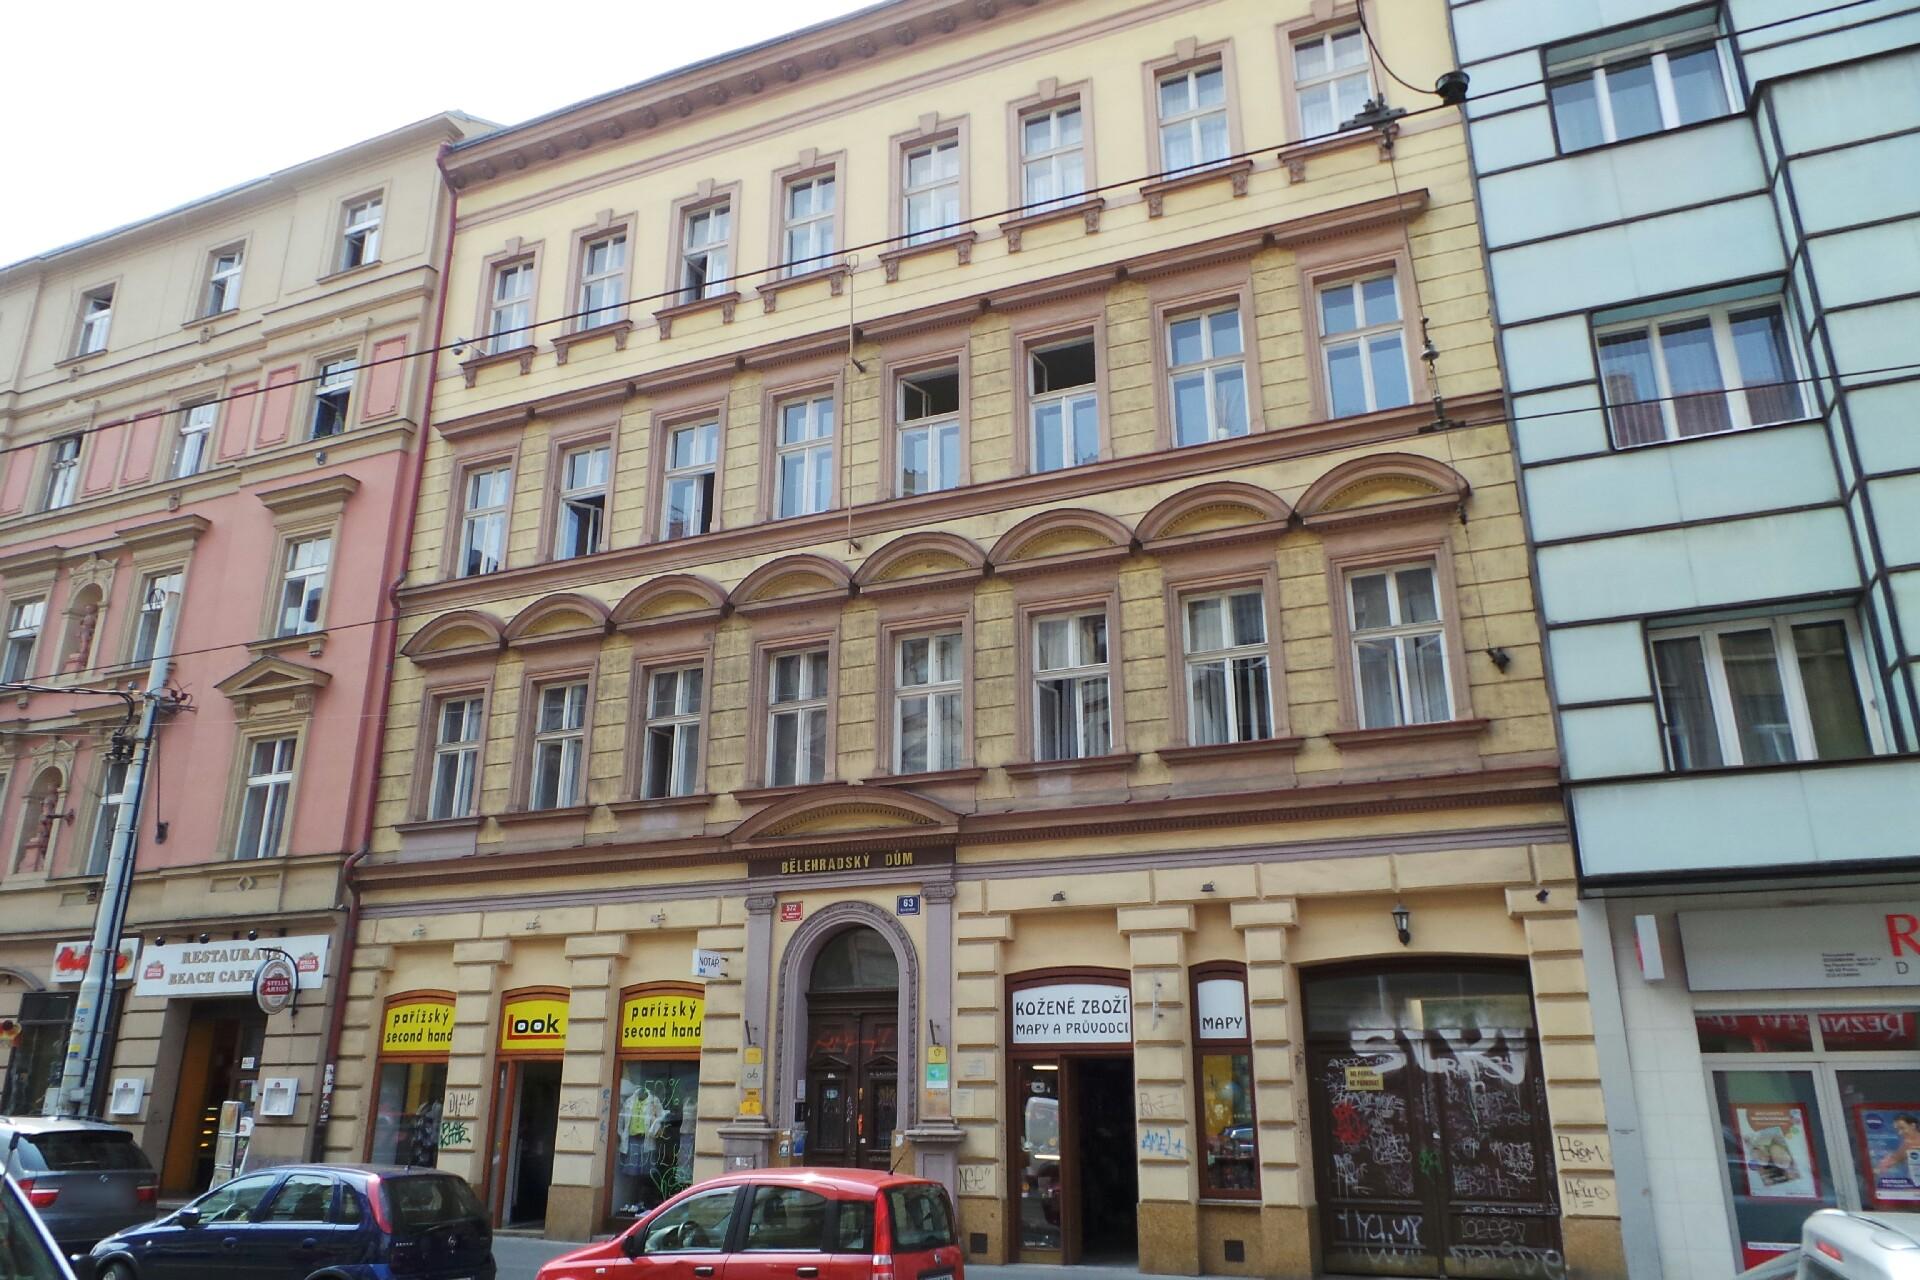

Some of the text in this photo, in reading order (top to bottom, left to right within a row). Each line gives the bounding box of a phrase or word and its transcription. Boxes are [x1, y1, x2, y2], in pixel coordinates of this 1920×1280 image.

[781, 852, 870, 874] BĚLEHRADSKÝ
[902, 898, 914, 908] 63
[699, 956, 720, 968] NOTÁŘ
[168, 972, 215, 986] BEACH
[632, 1000, 697, 1022] pařížský
[1015, 995, 1128, 1016] KOŽENÉ ZBOŽÍ
[393, 1008, 449, 1028] pařížský
[1202, 1016, 1243, 1030] MAPY
[507, 1013, 561, 1040] Look
[624, 1021, 701, 1038] second hand
[1016, 1020, 1129, 1036] MAPY A PRŮVODCI
[386, 1027, 453, 1043] second hand
